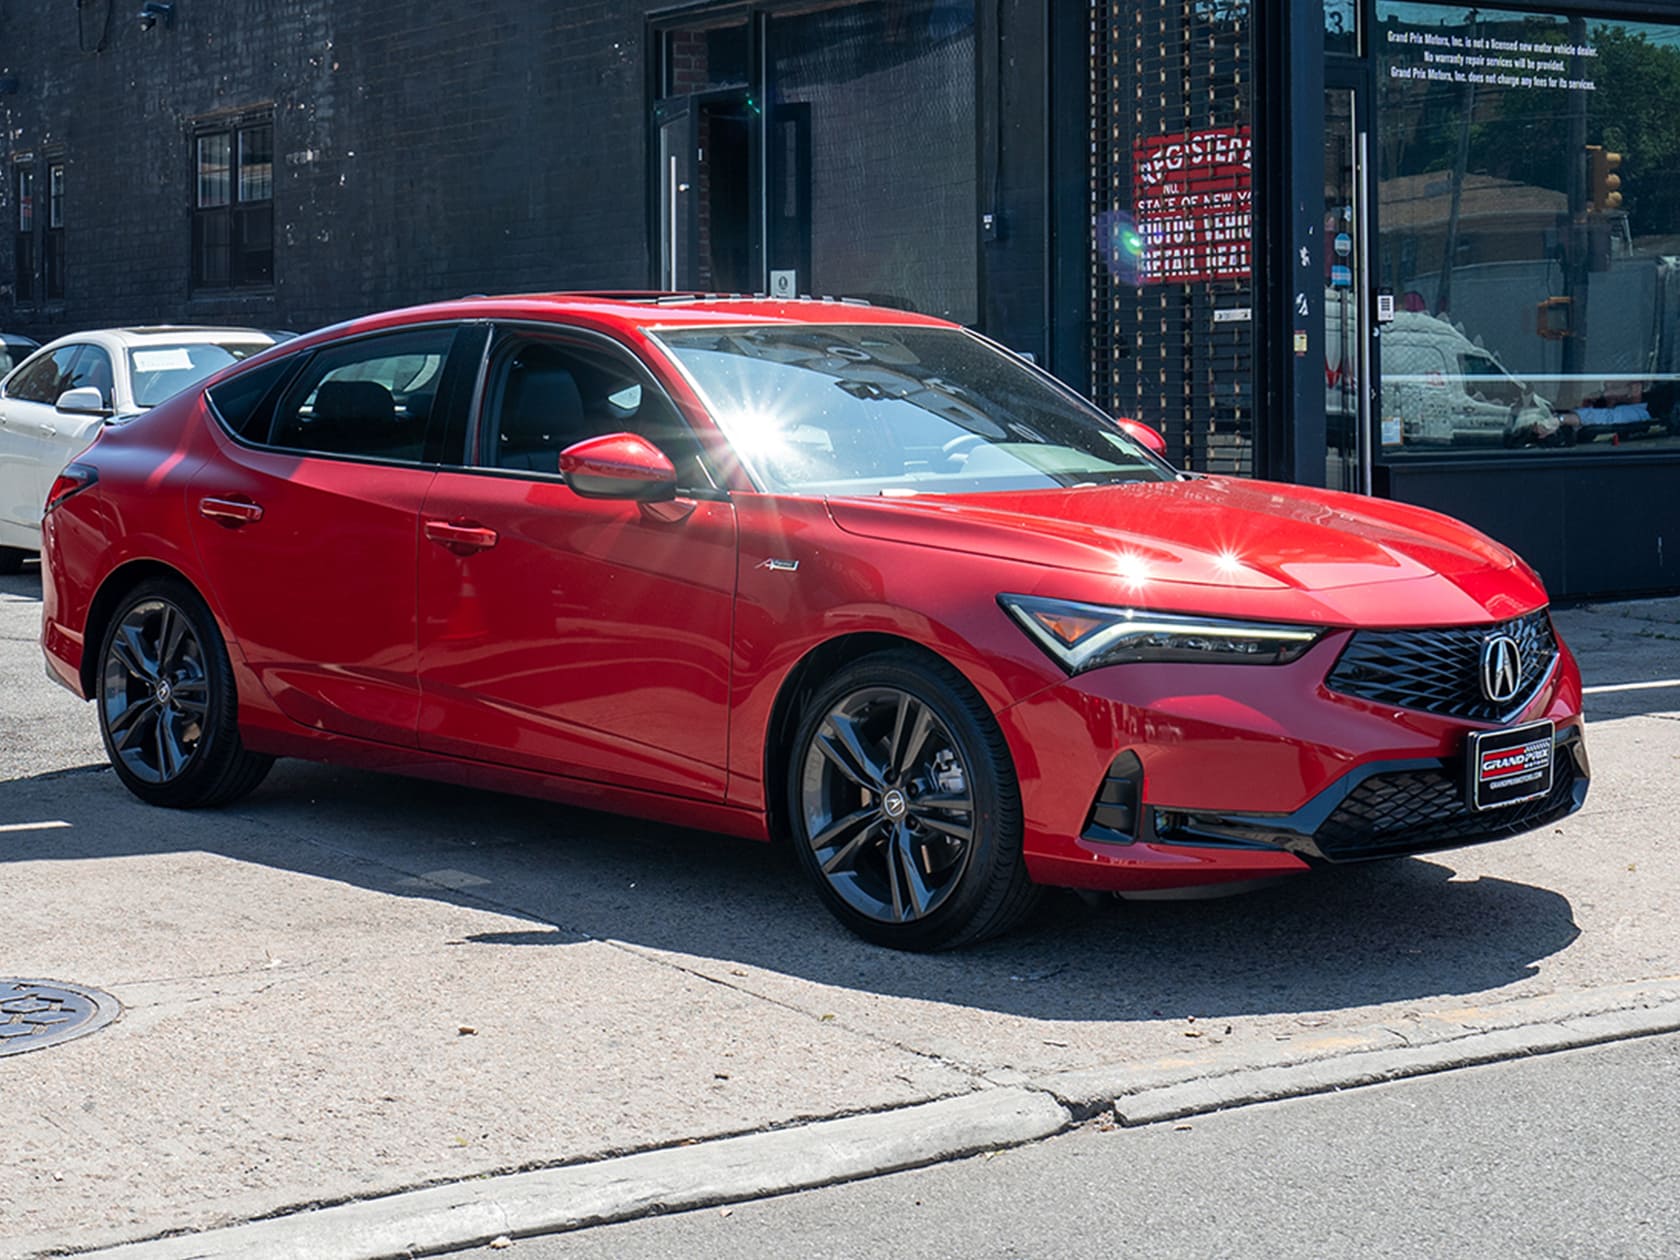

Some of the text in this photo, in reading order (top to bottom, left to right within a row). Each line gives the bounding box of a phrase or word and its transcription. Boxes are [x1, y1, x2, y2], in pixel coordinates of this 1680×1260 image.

[1387, 30, 1408, 43] Grand
[1409, 32, 1423, 44] Prix
[1424, 33, 1450, 47] Motors,
[1451, 35, 1464, 47] Inc.
[1465, 36, 1472, 48] is
[1473, 38, 1485, 49] not
[1490, 38, 1518, 51] licensed
[1519, 43, 1532, 52] new
[1533, 42, 1553, 53] motor
[1553, 43, 1576, 55] vehicle
[1577, 45, 1599, 57] dealer.
[1424, 51, 1565, 71] No warranty repair services will be provided.
[1390, 66, 1412, 78] Grand
[1412, 67, 1426, 79] Prix
[1427, 68, 1453, 82] Motors,
[1454, 70, 1467, 82] Inc.
[1468, 72, 1484, 83] does
[1485, 73, 1496, 84] not
[1497, 74, 1519, 87] charge
[1520, 77, 1532, 88] any
[1533, 76, 1547, 87] fees
[1548, 77, 1558, 87] for
[1568, 79, 1596, 90] services.
[1140, 133, 1251, 185] REGISTER
[1203, 193, 1233, 209] NEW
[1138, 216, 1196, 245] MOTOR
[1140, 248, 1199, 278] RETAIL
[1483, 749, 1549, 771] GRAND PRIX
